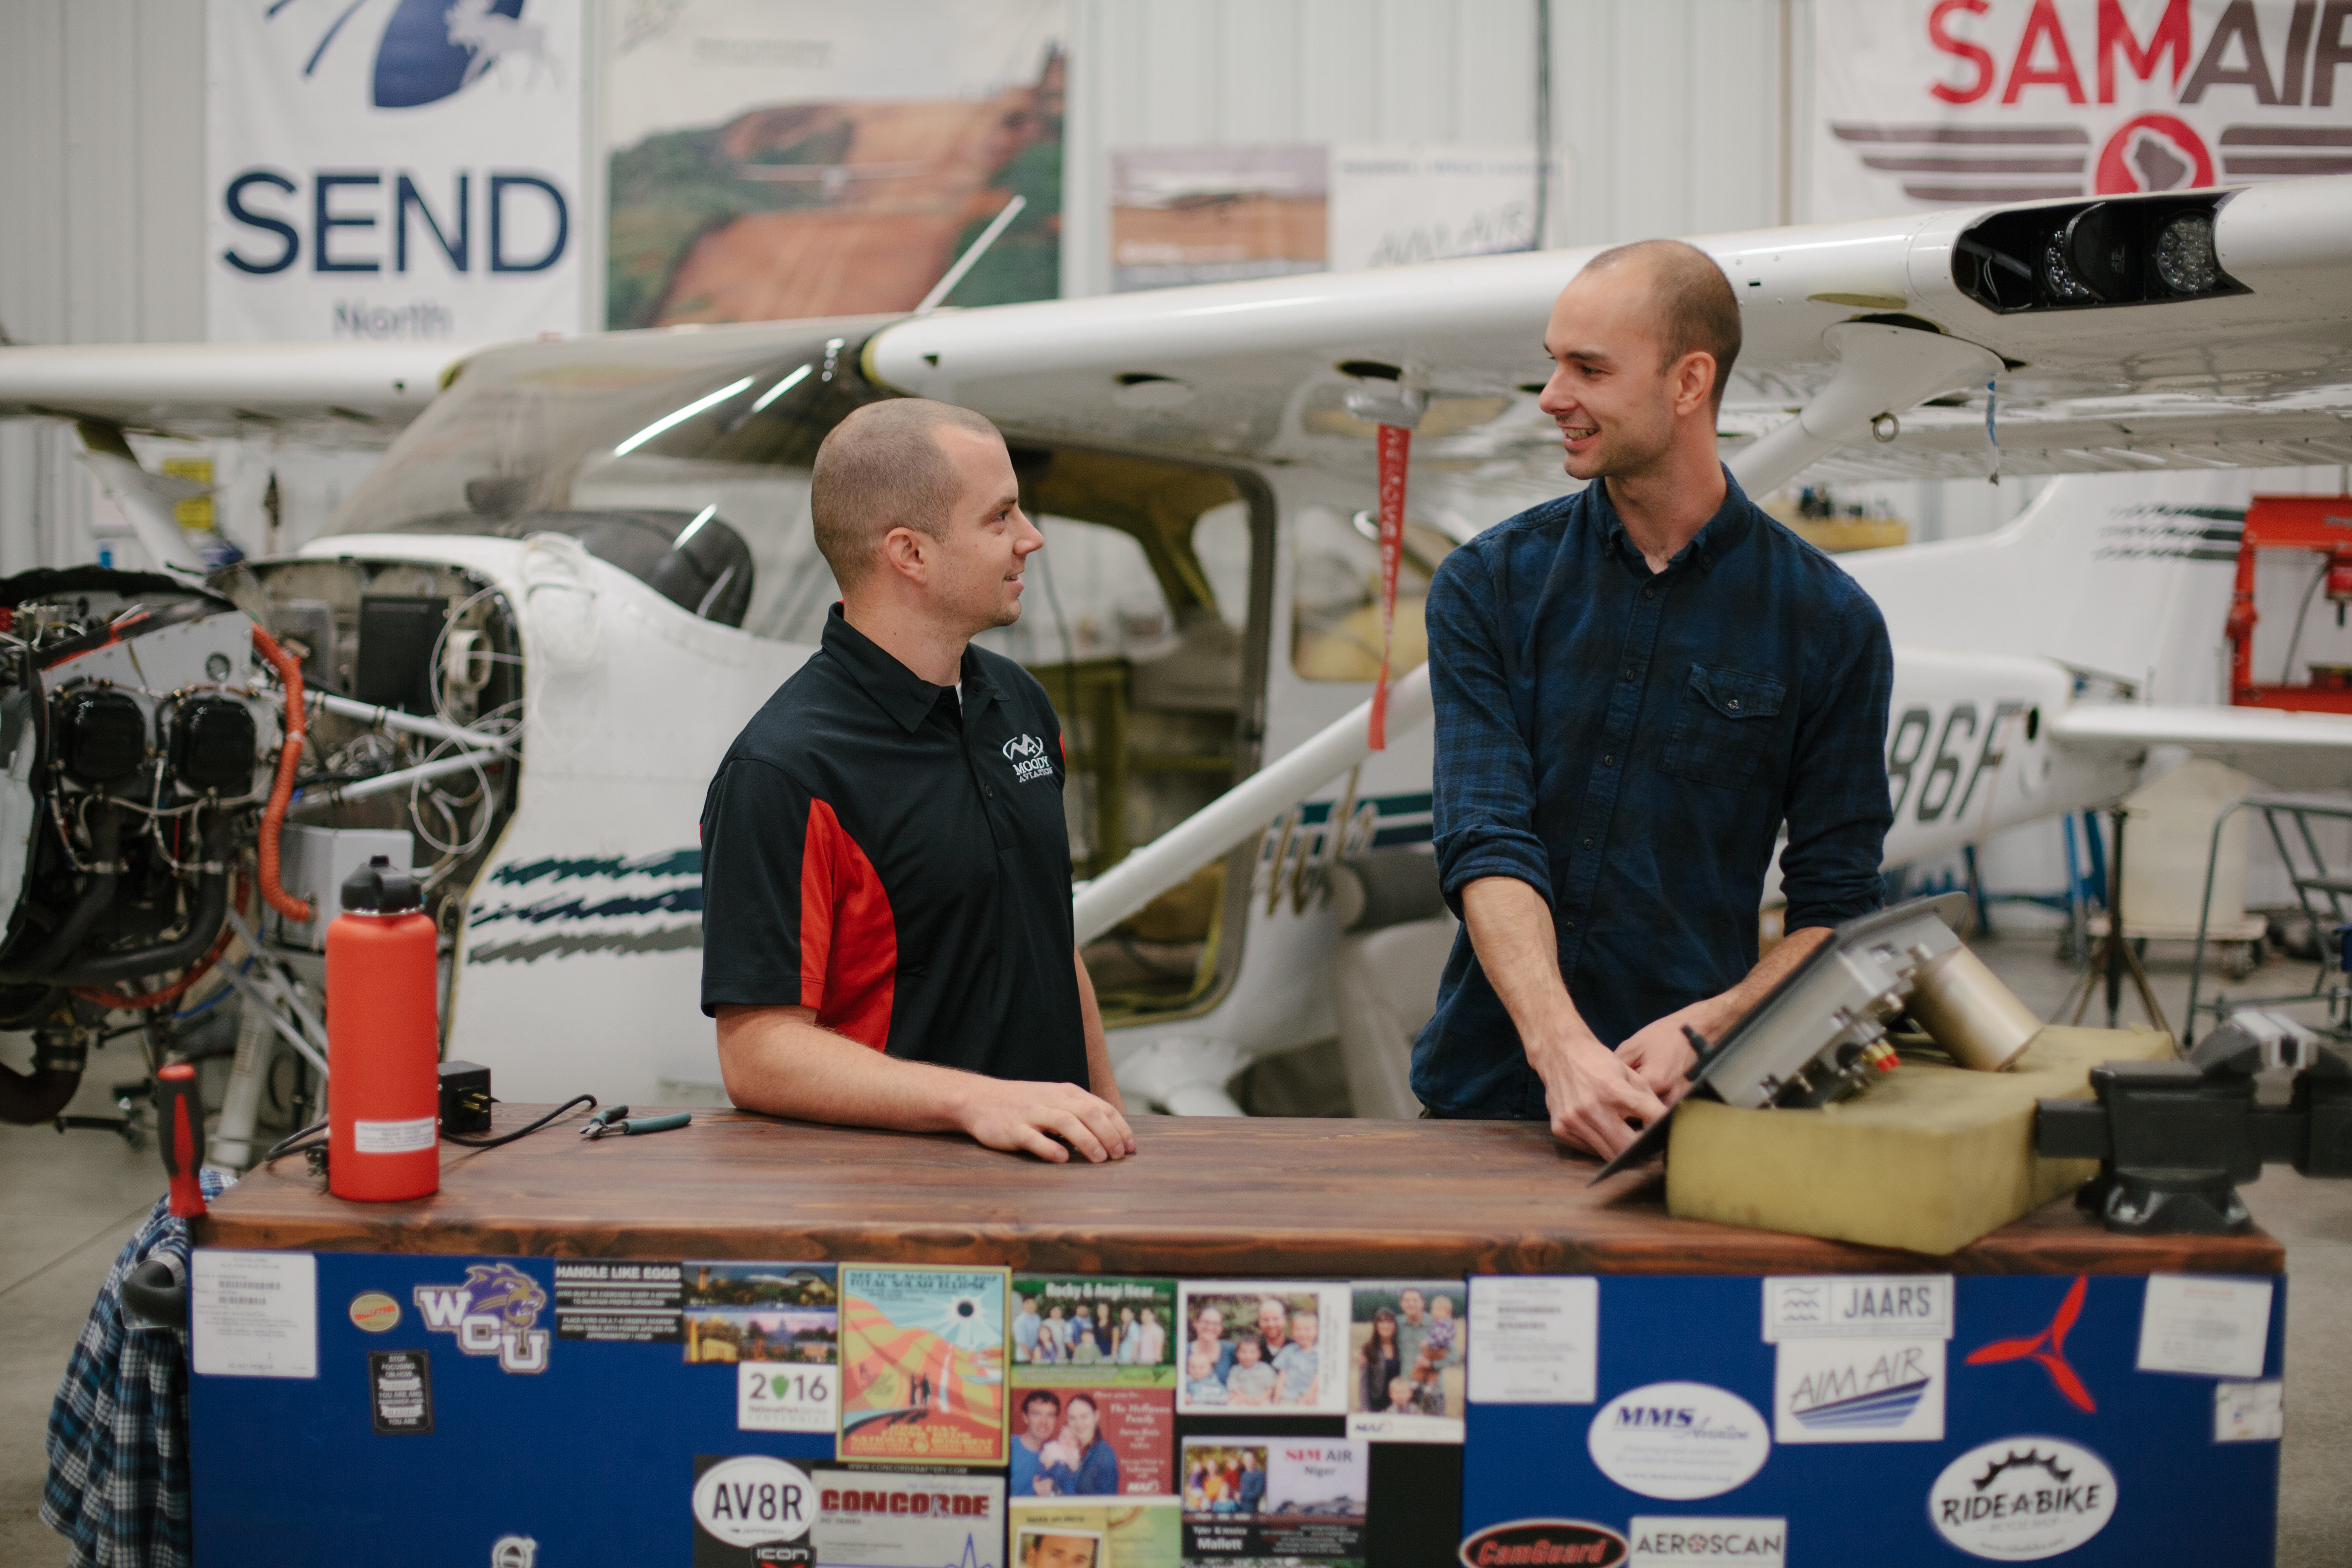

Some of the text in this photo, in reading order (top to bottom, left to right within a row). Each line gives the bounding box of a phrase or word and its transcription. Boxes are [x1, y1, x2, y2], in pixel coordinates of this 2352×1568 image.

[223, 171, 568, 275] SEND
[334, 298, 452, 337] North
[1012, 756, 1050, 776] MOODY
[1019, 767, 1053, 783] AVIATION
[556, 1266, 680, 1279] HANDLE LIKE EGGS
[851, 1279, 985, 1290] TOTAL SOLAR ECLIPSE
[1047, 1282, 1082, 1300] Rocky
[1083, 1282, 1092, 1297] &
[1844, 1286, 1932, 1319] JAARS
[1791, 1347, 1929, 1413] AIM AIR
[1615, 1406, 1696, 1428] MMS
[1325, 1449, 1352, 1463] AIR
[1305, 1466, 1336, 1478] Niger
[712, 1483, 803, 1522] AV8R
[821, 1489, 989, 1518] CONCORDE
[1197, 1538, 1243, 1550] Mallett
[1479, 1538, 1607, 1565] CamGuard
[1635, 1533, 1782, 1556] AEROSCAN
